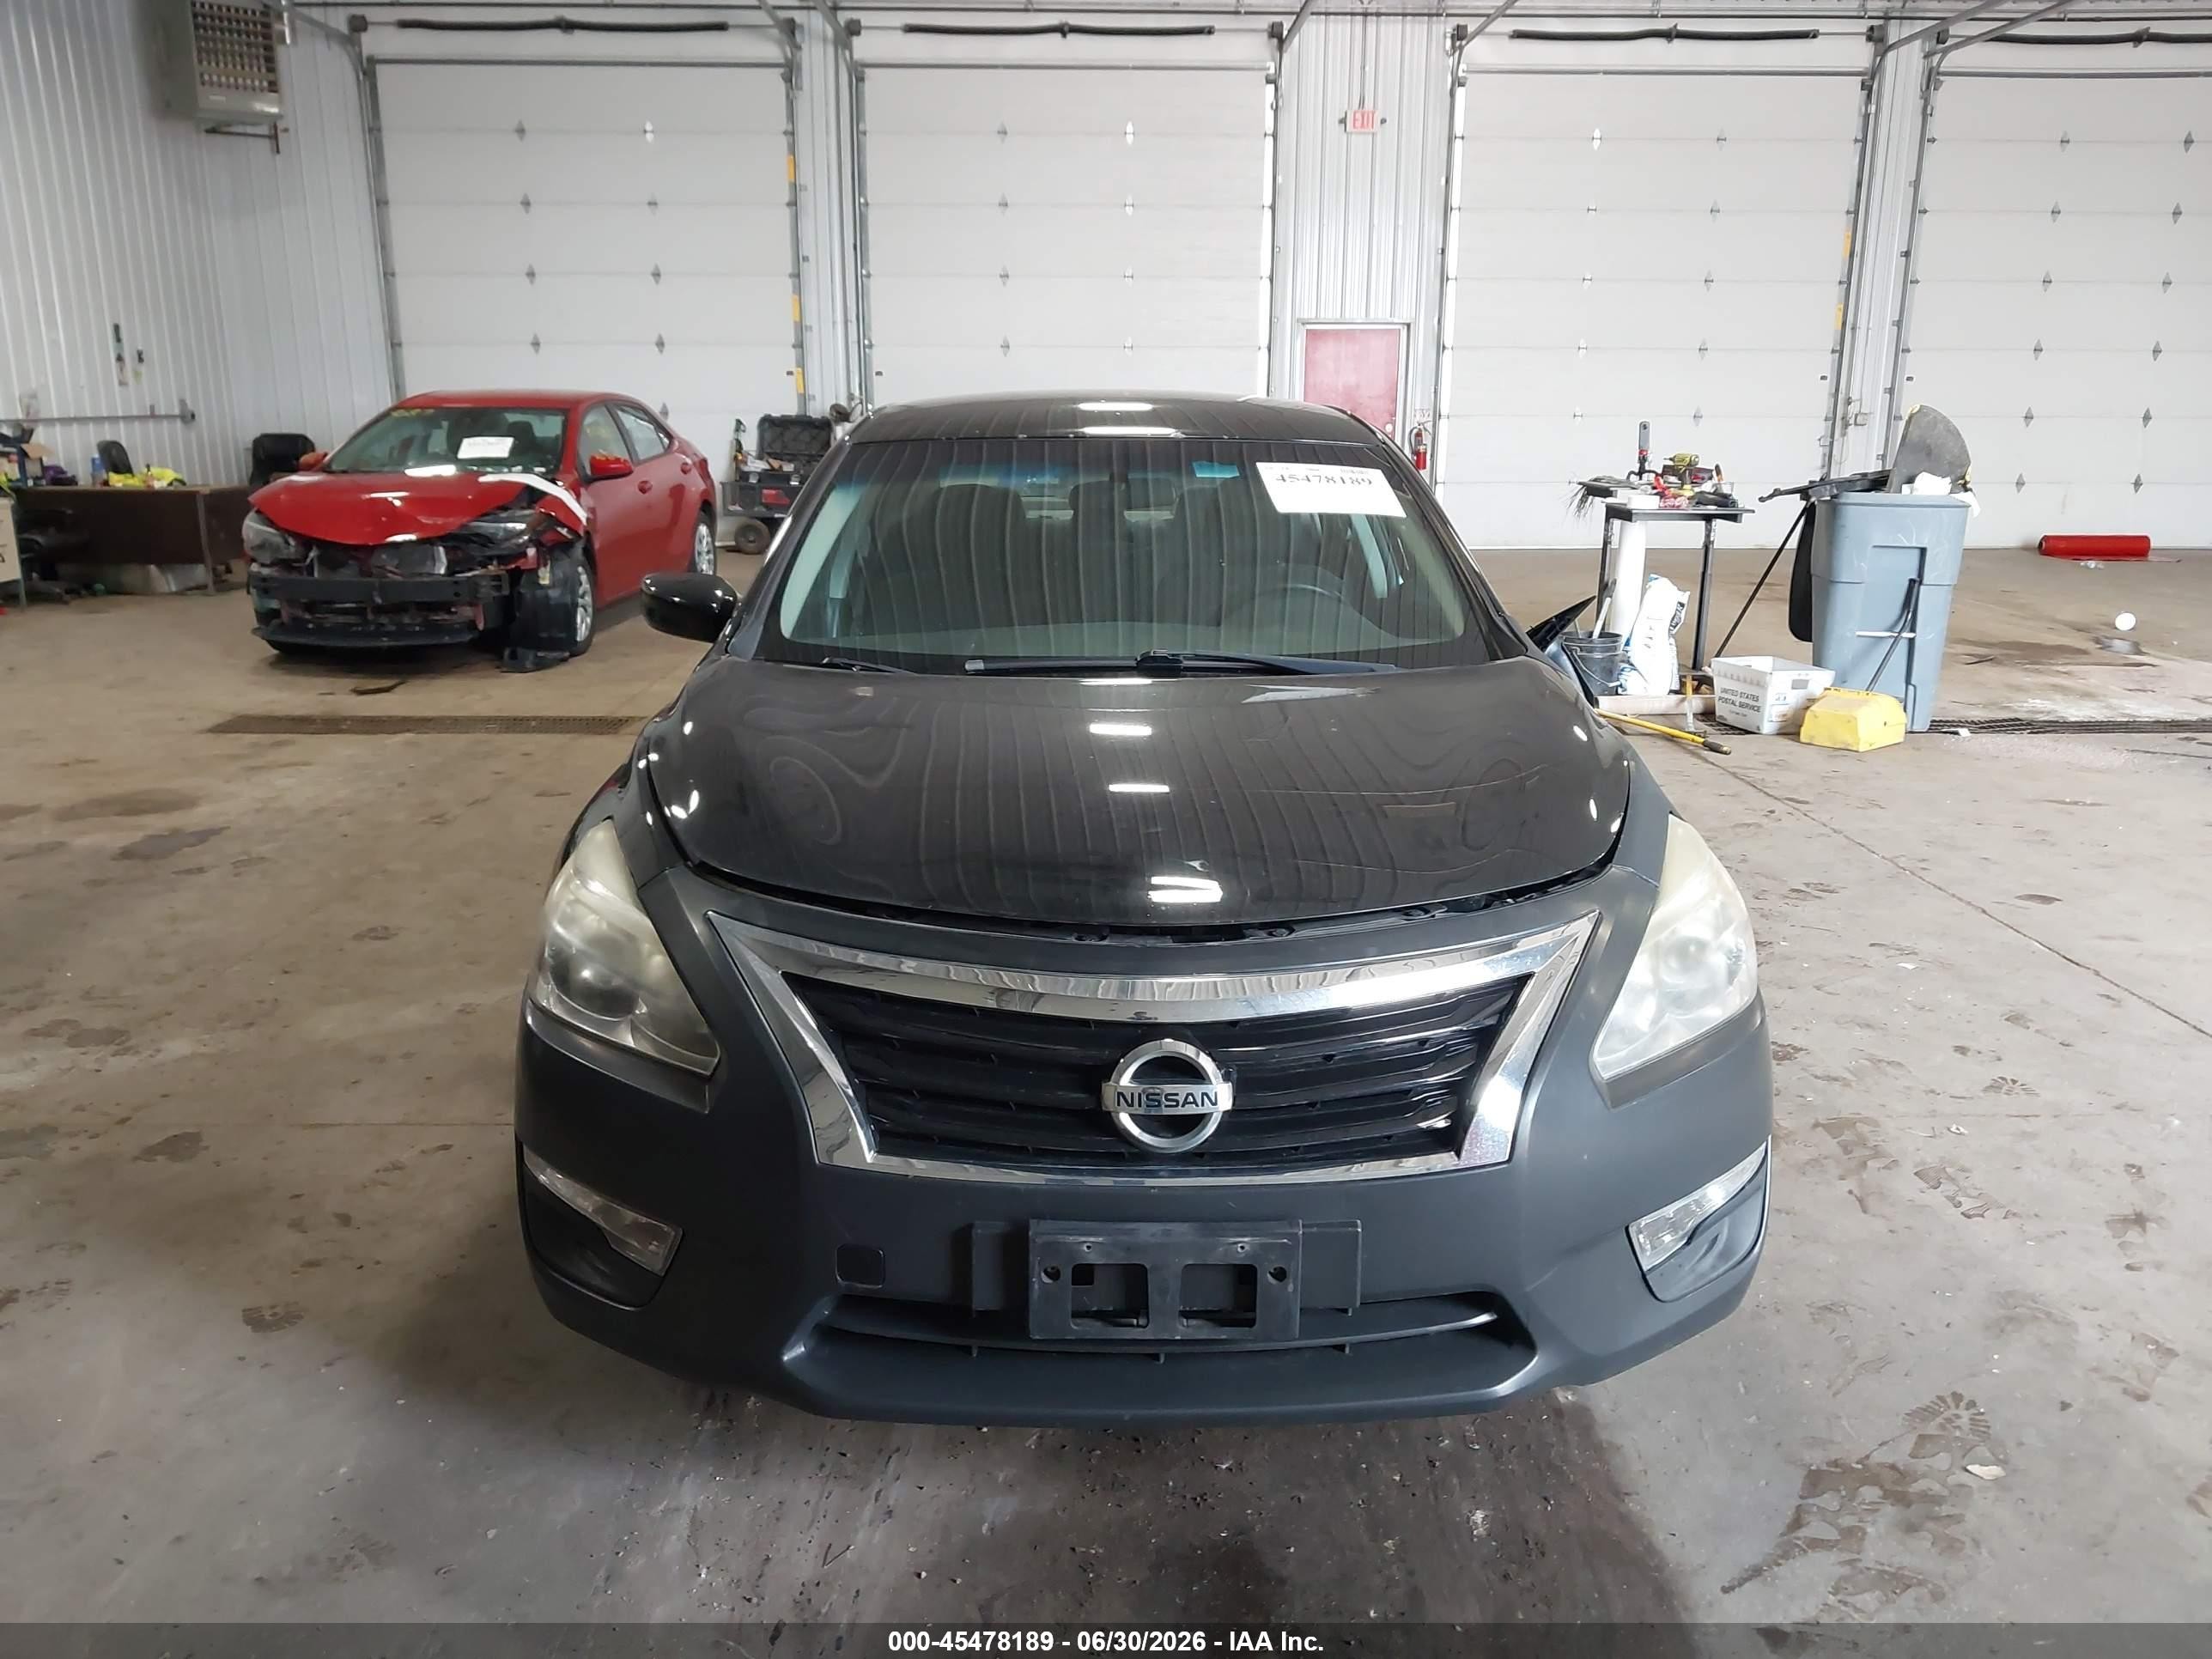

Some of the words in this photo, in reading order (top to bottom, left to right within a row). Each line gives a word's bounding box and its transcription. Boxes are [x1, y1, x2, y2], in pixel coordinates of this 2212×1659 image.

[1352, 111, 1376, 129] EXIT
[1275, 474, 1373, 485] 45478189
[1720, 687, 1739, 696] UNITED
[1739, 691, 1759, 702] STATES
[1717, 696, 1737, 707] POSTAL
[1738, 700, 1761, 713] SERVICE
[1116, 1091, 1218, 1109] NISSAN
